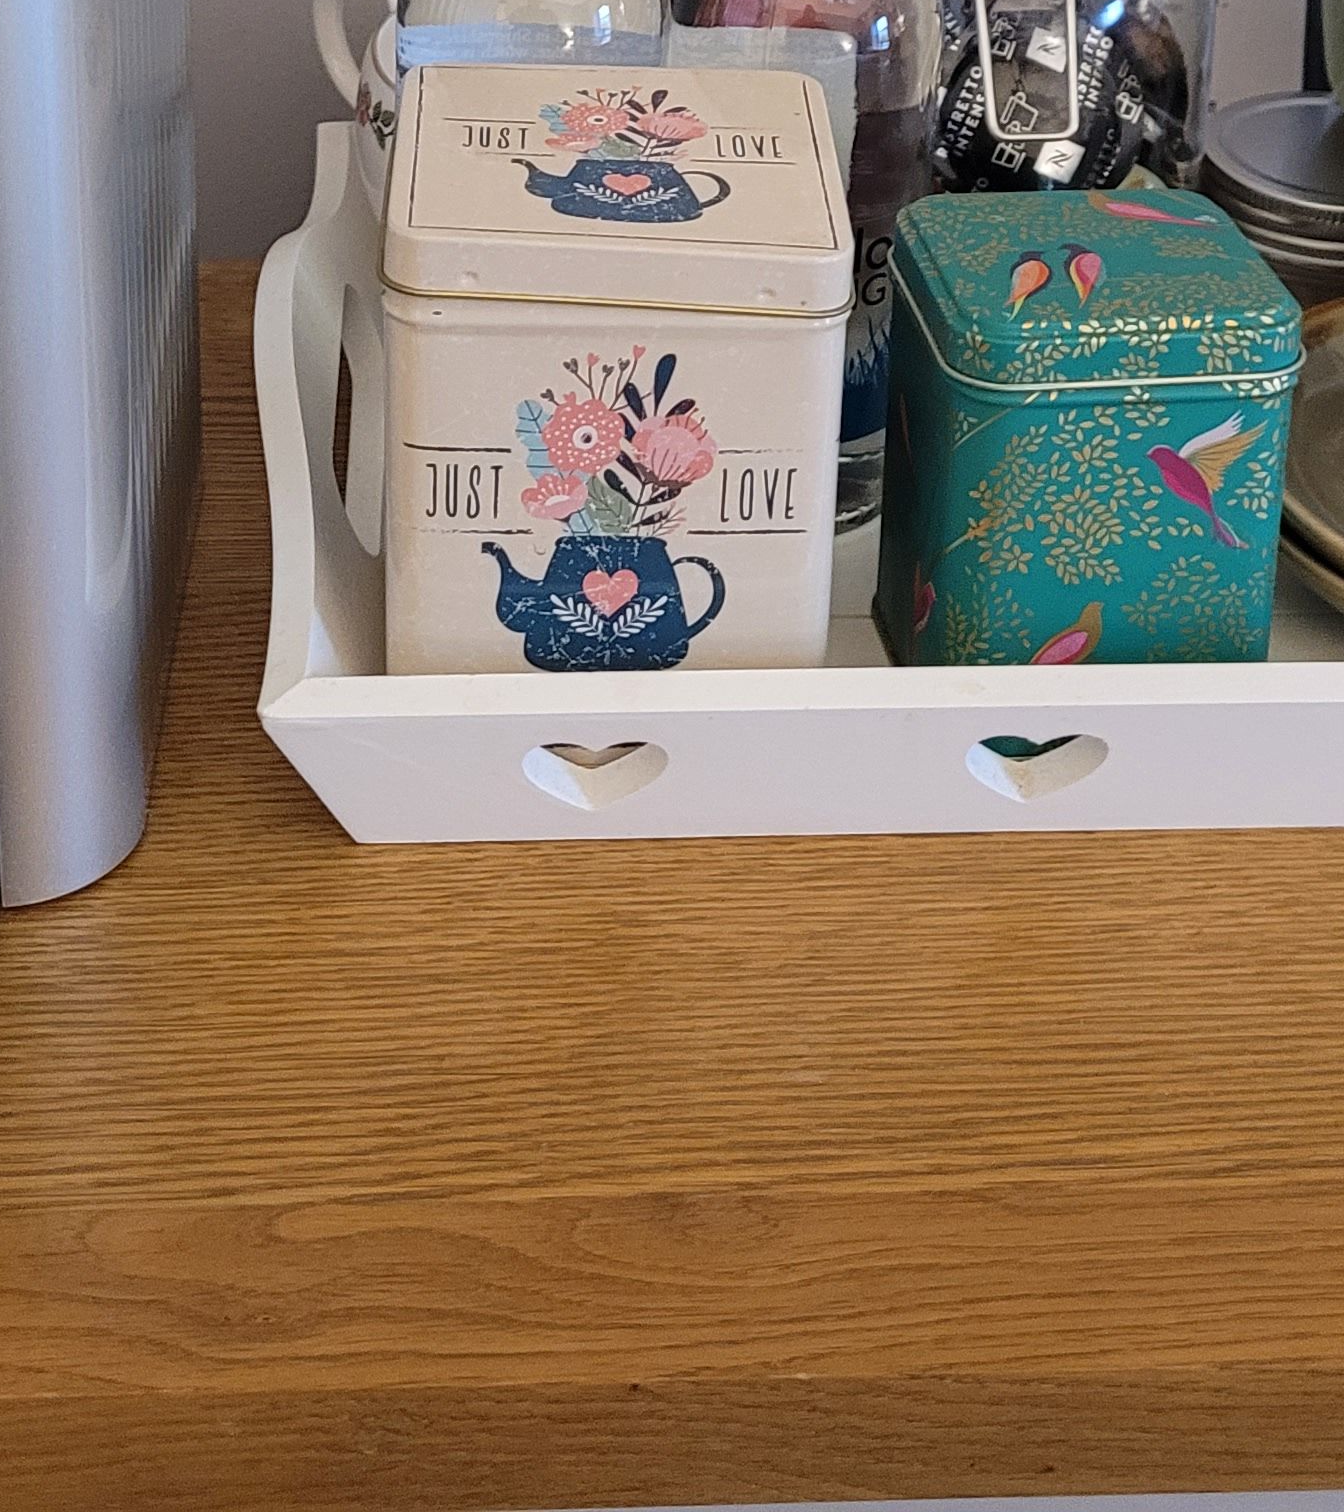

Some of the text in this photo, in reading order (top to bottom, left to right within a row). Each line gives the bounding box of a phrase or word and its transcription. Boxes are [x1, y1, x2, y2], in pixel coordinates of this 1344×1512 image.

[462, 125, 784, 160] JUST LOVE
[425, 463, 799, 523] JUST LOVE
